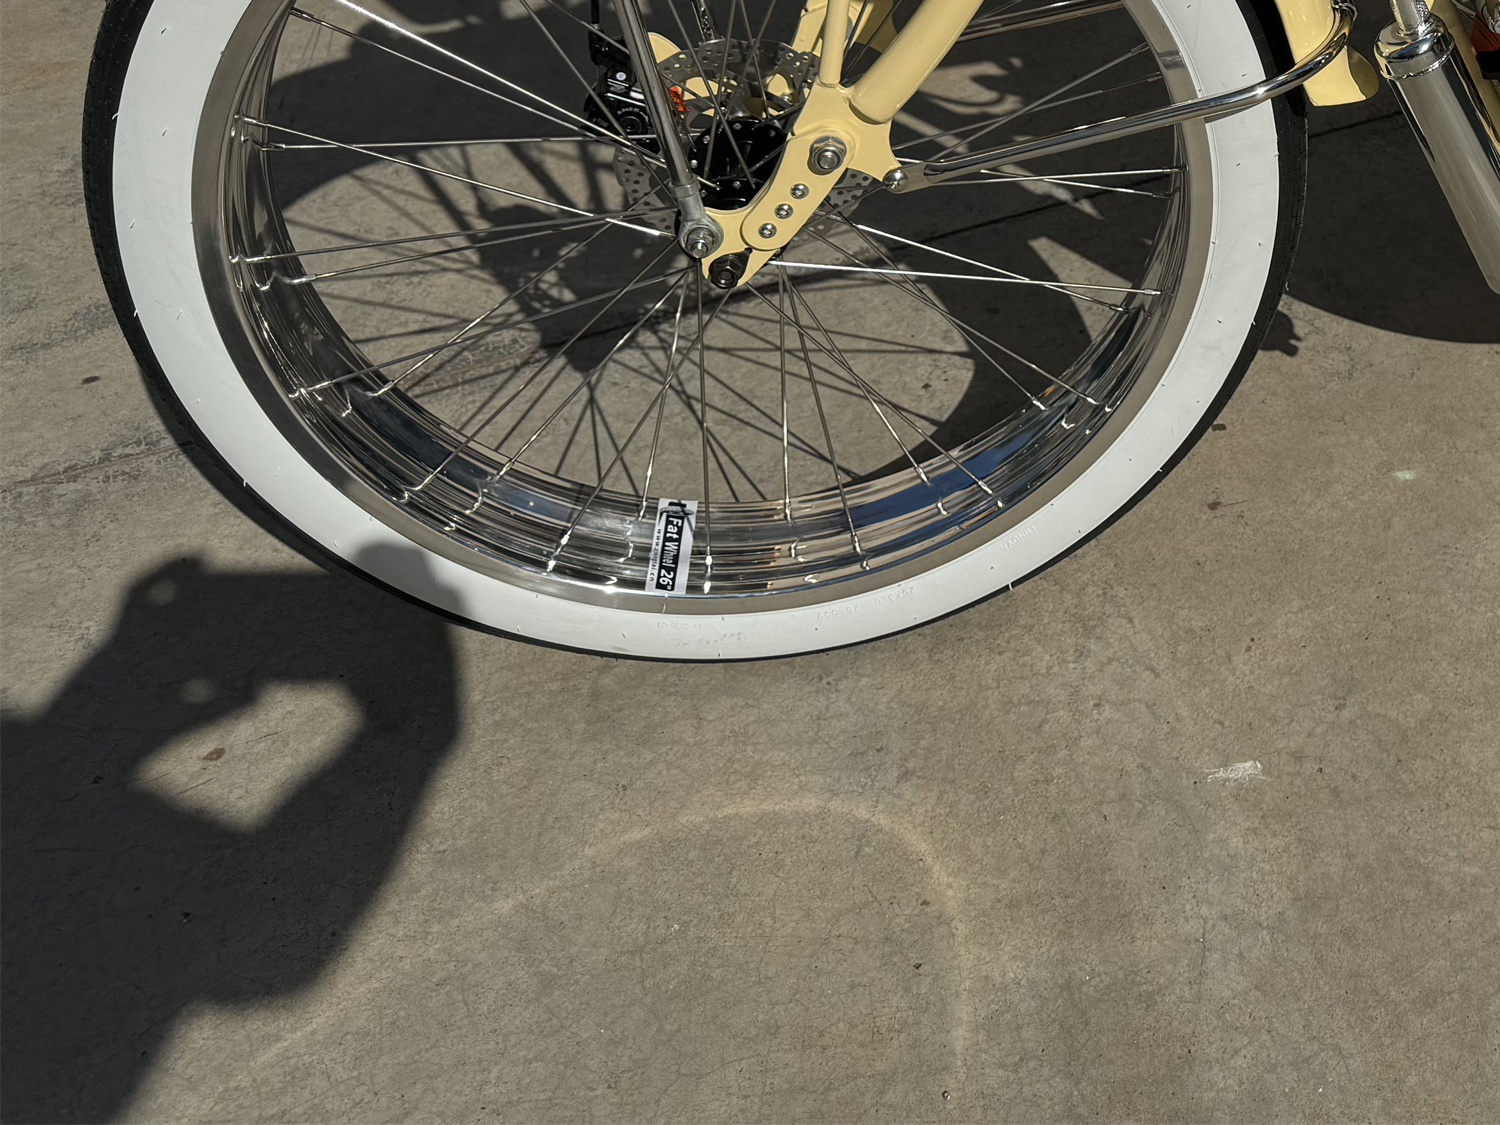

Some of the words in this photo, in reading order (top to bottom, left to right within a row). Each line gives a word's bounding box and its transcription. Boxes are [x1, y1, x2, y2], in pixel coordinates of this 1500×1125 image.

[666, 517, 682, 539] Fat
[1000, 524, 1037, 551] INNOVA
[661, 540, 678, 567] Wheel
[658, 568, 673, 589] 26"
